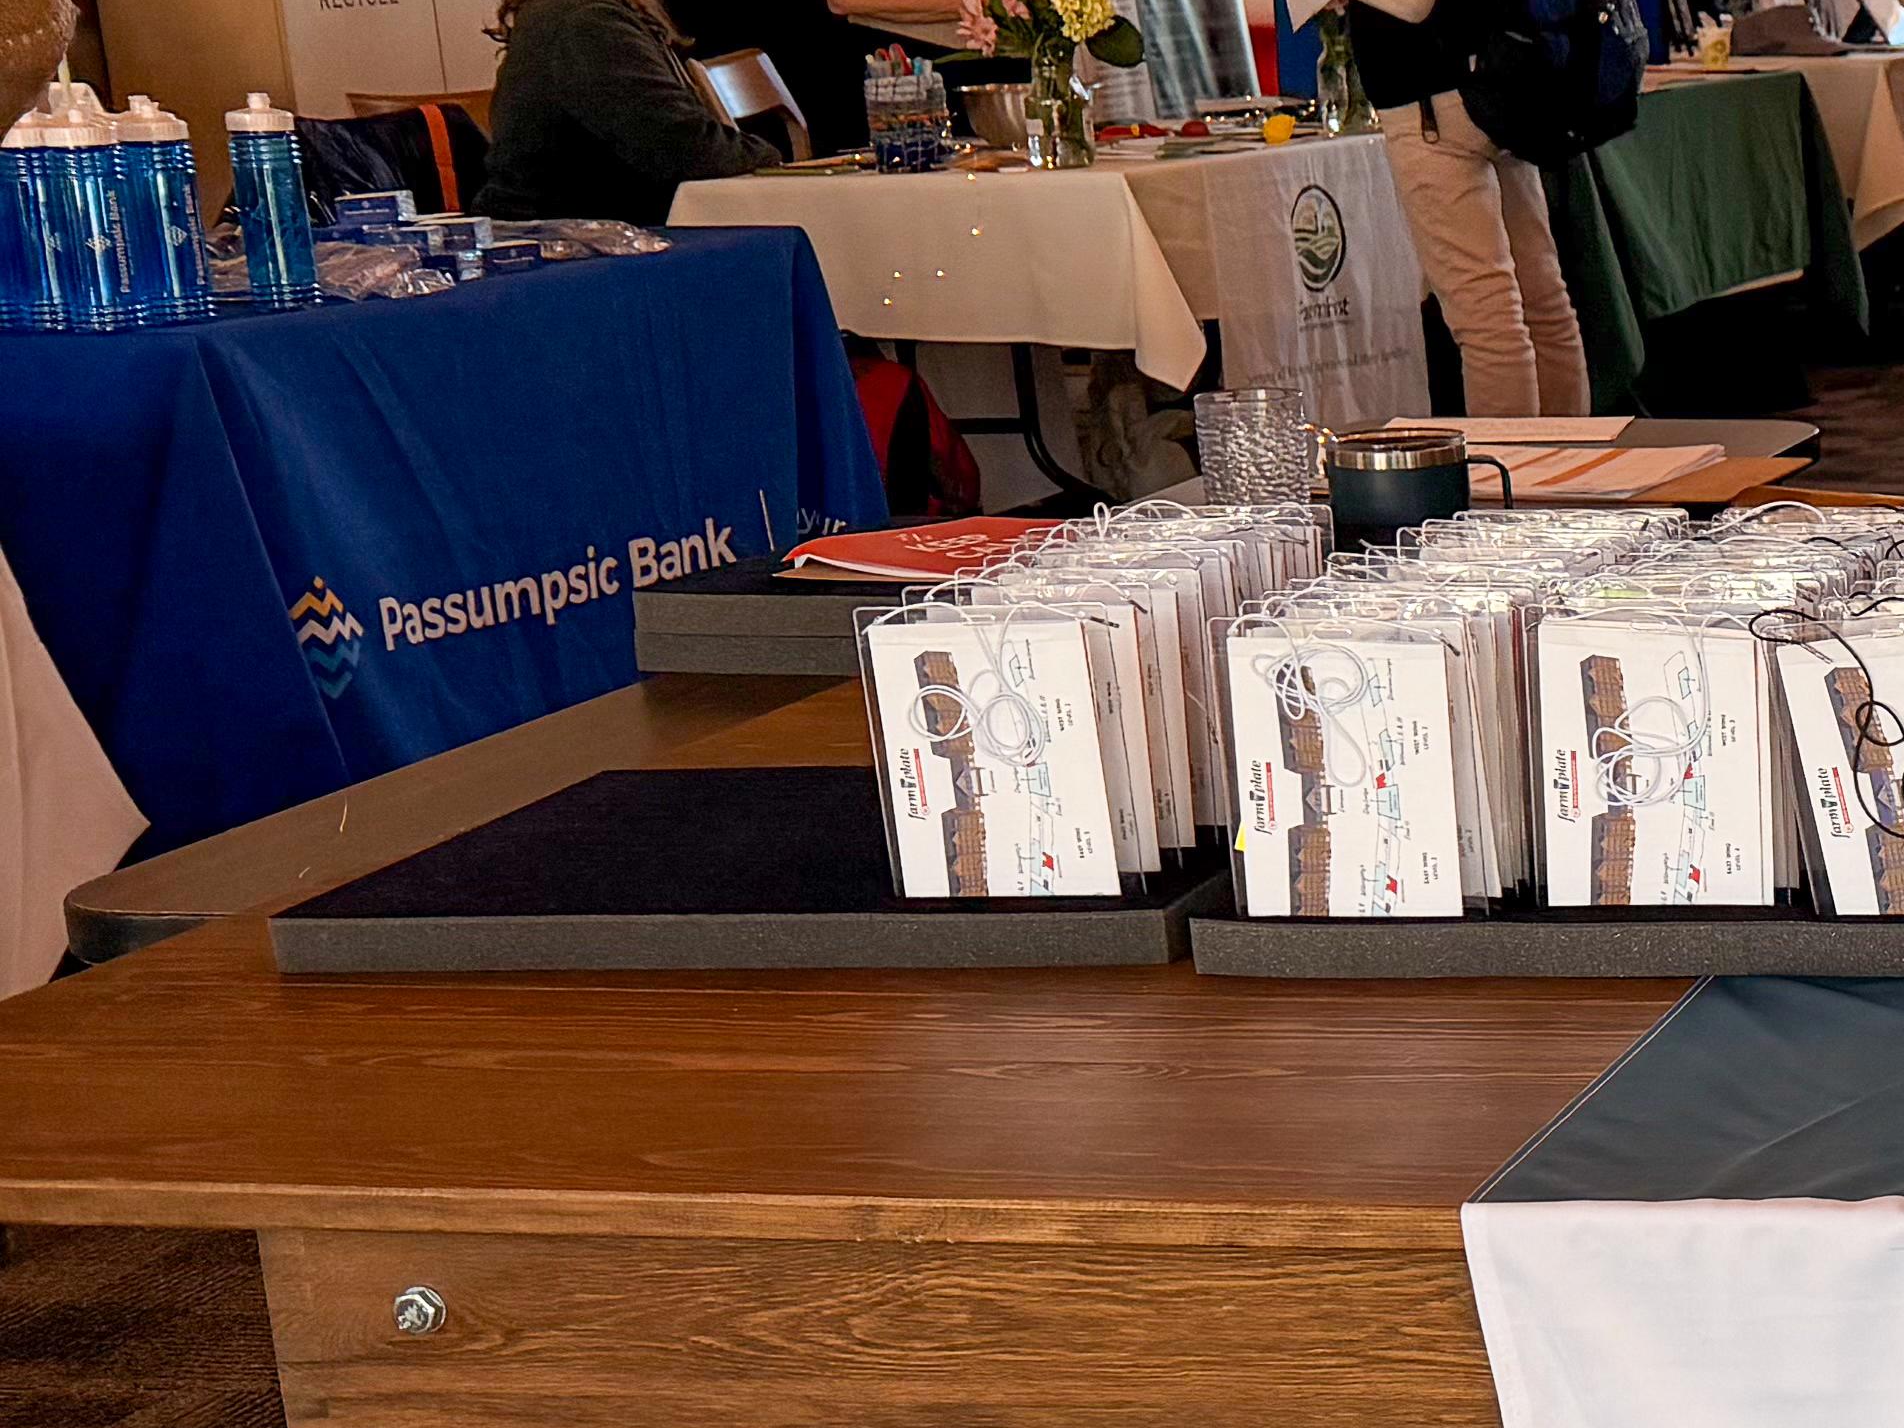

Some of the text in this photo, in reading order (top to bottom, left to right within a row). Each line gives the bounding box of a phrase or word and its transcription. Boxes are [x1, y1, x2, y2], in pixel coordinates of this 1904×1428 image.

[380, 545, 618, 650] Passumpsic
[630, 517, 736, 589] Bank
[900, 748, 926, 820] farm plate
[1250, 760, 1273, 835] farm plate
[1555, 749, 1575, 822] farm plate
[1817, 767, 1850, 838] farm plate
